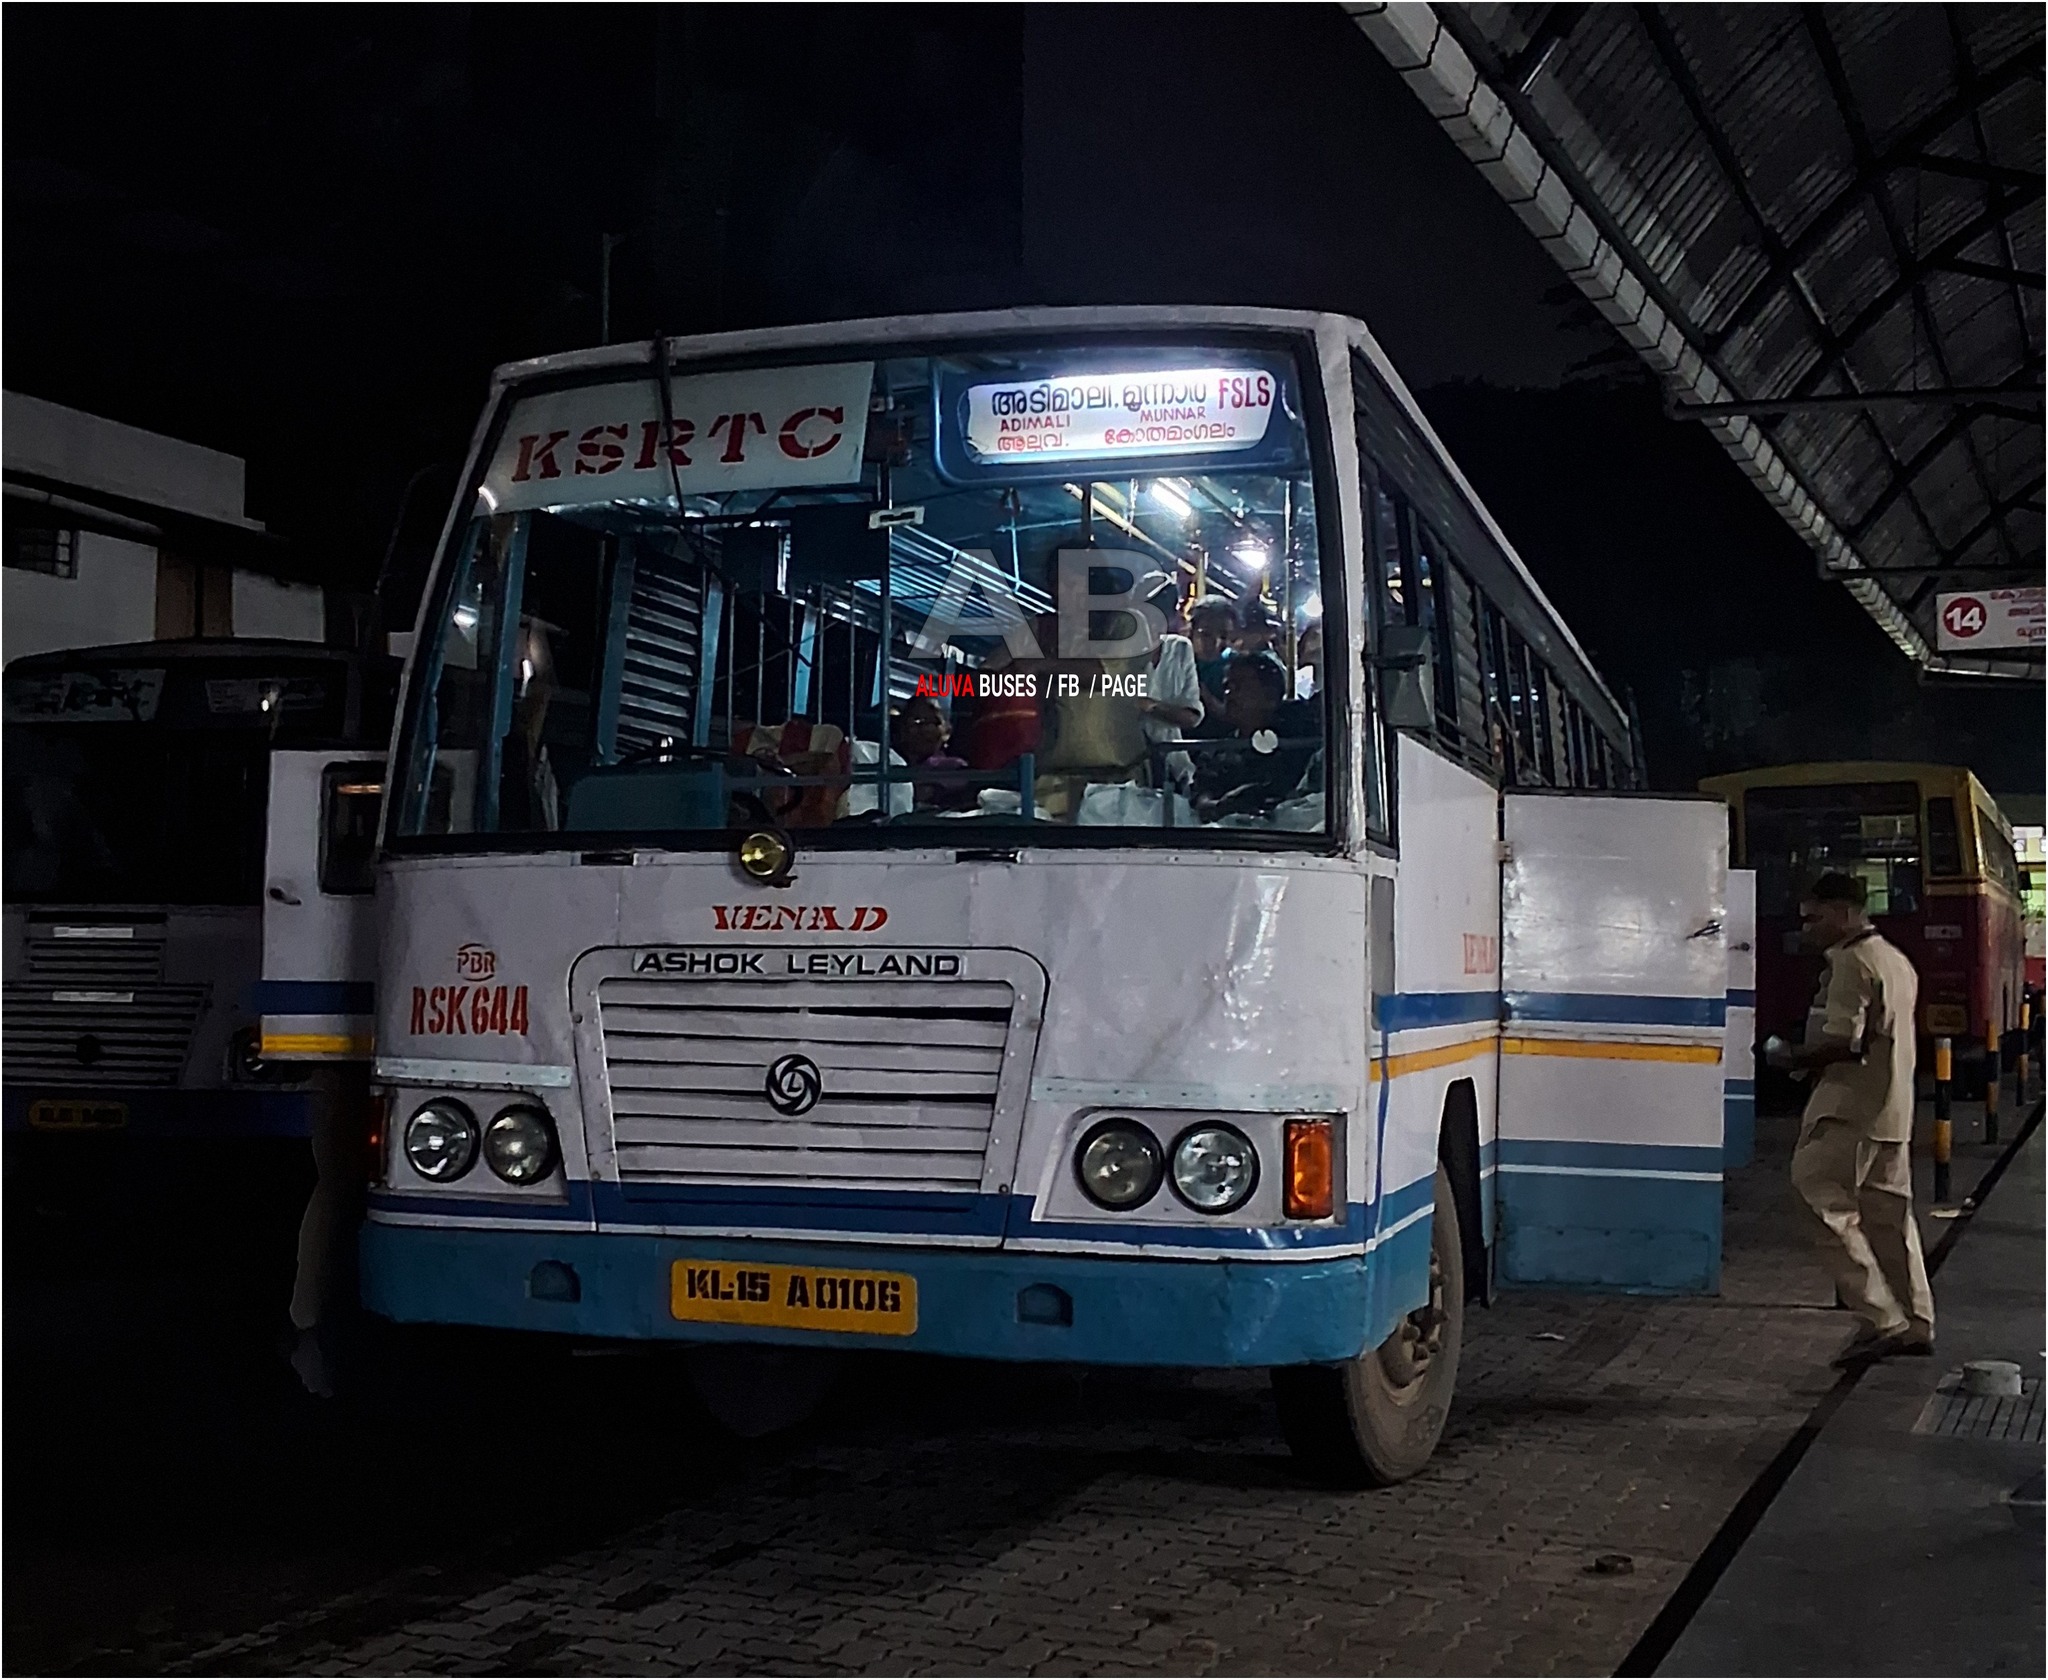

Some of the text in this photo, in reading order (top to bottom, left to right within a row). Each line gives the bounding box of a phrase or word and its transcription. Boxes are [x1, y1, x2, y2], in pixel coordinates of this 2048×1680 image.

[1218, 376, 1271, 410] FSLS
[1000, 406, 1206, 433] ADIMALI MUNNAR
[511, 406, 844, 482] KSRTC
[1946, 606, 1983, 631] 14
[712, 905, 888, 931] VENAD
[457, 952, 496, 974] PBR
[638, 953, 961, 976] ASHOK LEYLAND
